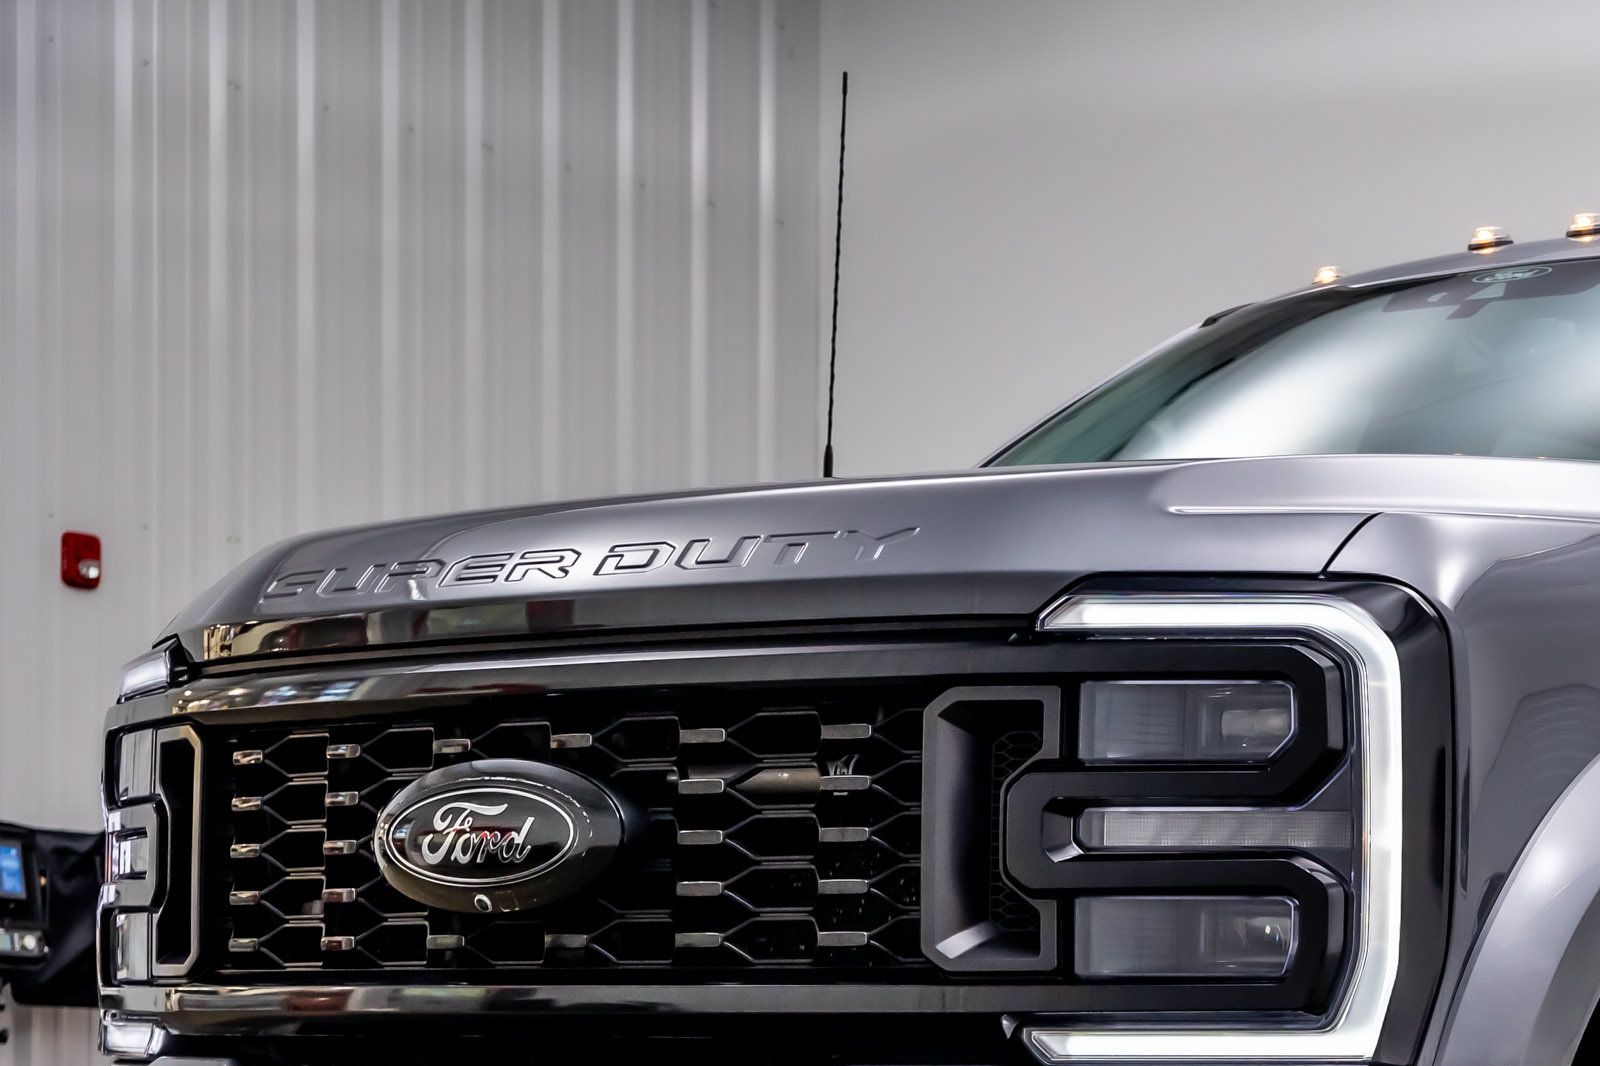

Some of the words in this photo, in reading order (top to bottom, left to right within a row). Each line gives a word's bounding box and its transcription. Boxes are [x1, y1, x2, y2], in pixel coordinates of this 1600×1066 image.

[258, 546, 582, 605] SUPER
[592, 526, 921, 577] DUTY
[421, 802, 536, 865] Ford
